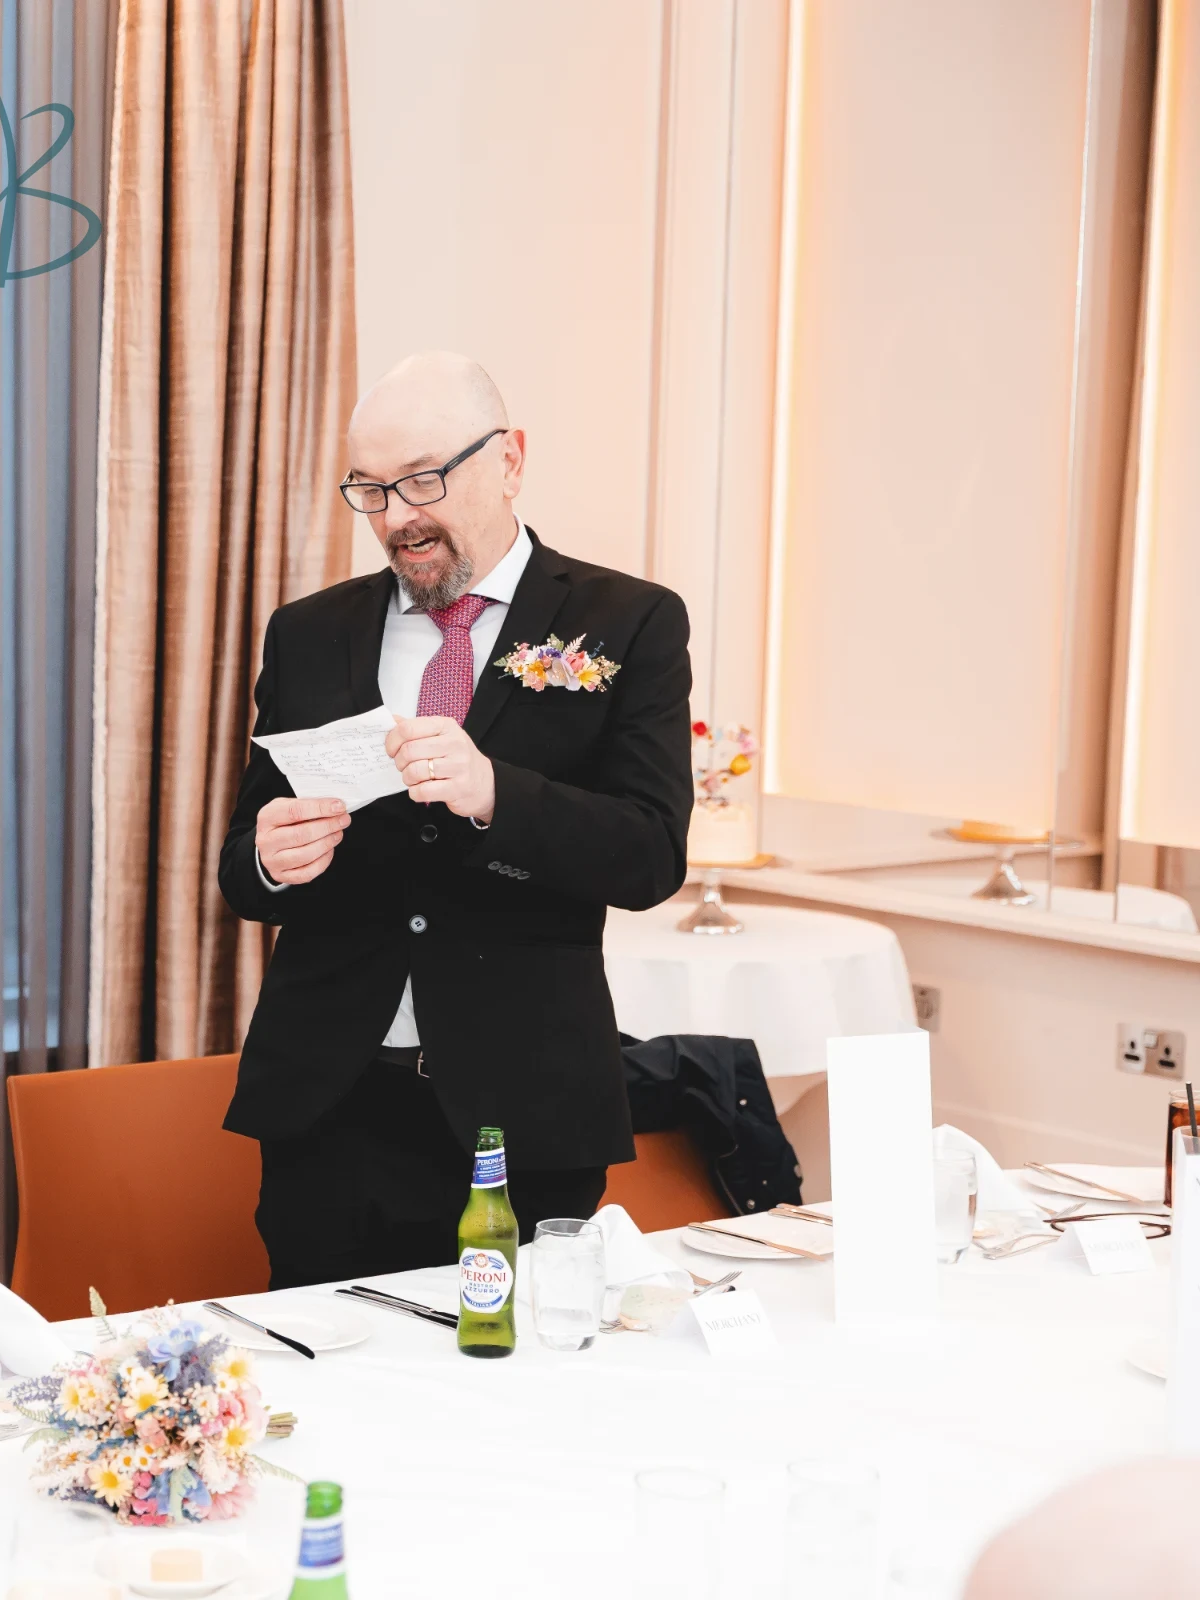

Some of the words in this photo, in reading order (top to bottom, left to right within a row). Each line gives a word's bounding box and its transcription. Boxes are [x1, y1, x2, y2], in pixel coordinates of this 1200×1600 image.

[477, 1157, 499, 1166] PERONI
[460, 1266, 507, 1283] PERONI
[464, 1285, 500, 1294] AZZURRO
[704, 1313, 761, 1331] MERCHANT
